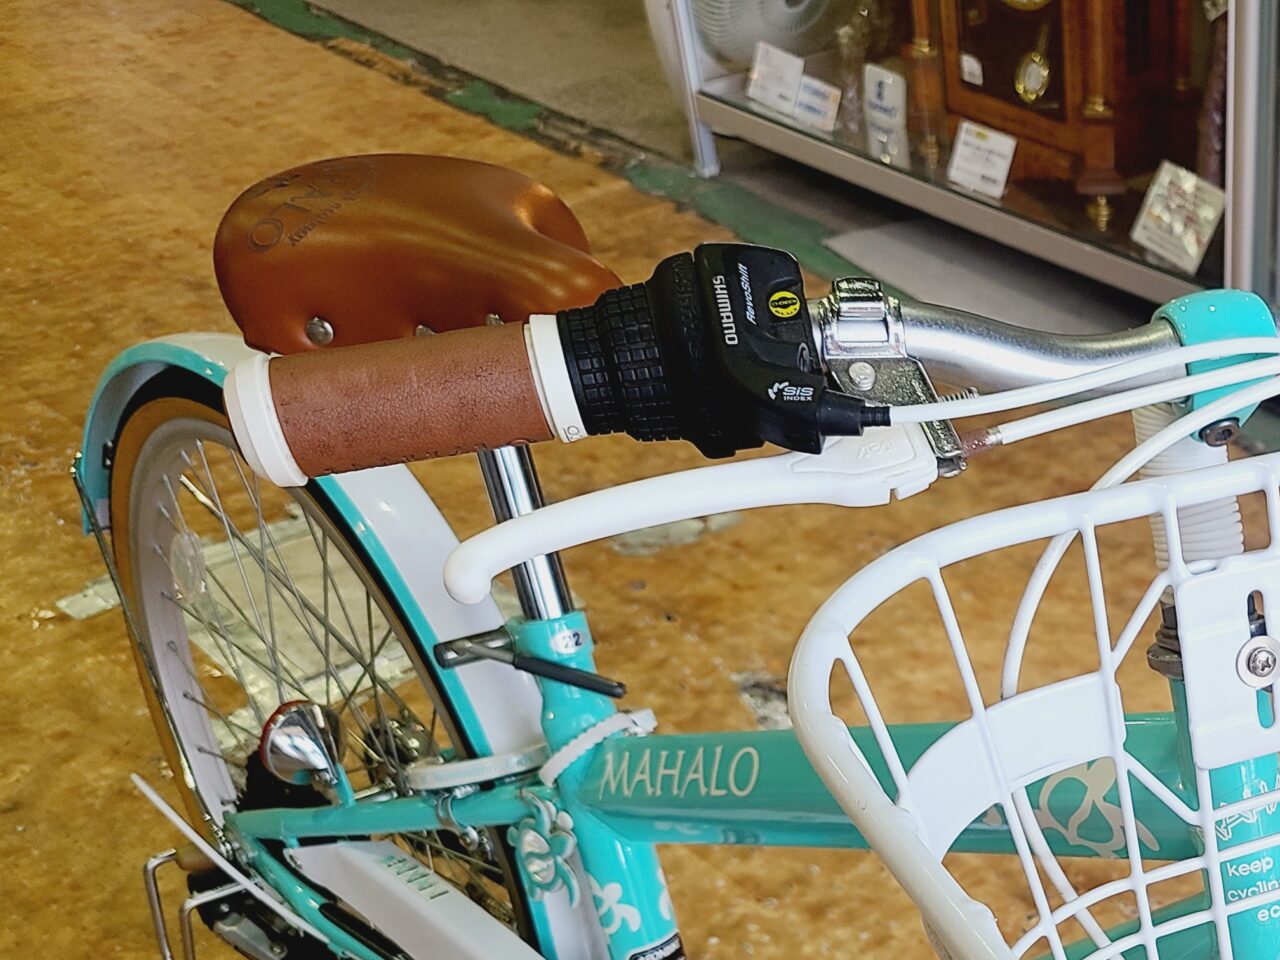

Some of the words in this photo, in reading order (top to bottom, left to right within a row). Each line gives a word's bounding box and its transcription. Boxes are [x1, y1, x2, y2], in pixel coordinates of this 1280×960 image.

[712, 275, 739, 346] SHIMANO
[737, 262, 757, 326] RevoShift
[599, 745, 760, 800] MAHALO
[1226, 856, 1274, 877] keep
